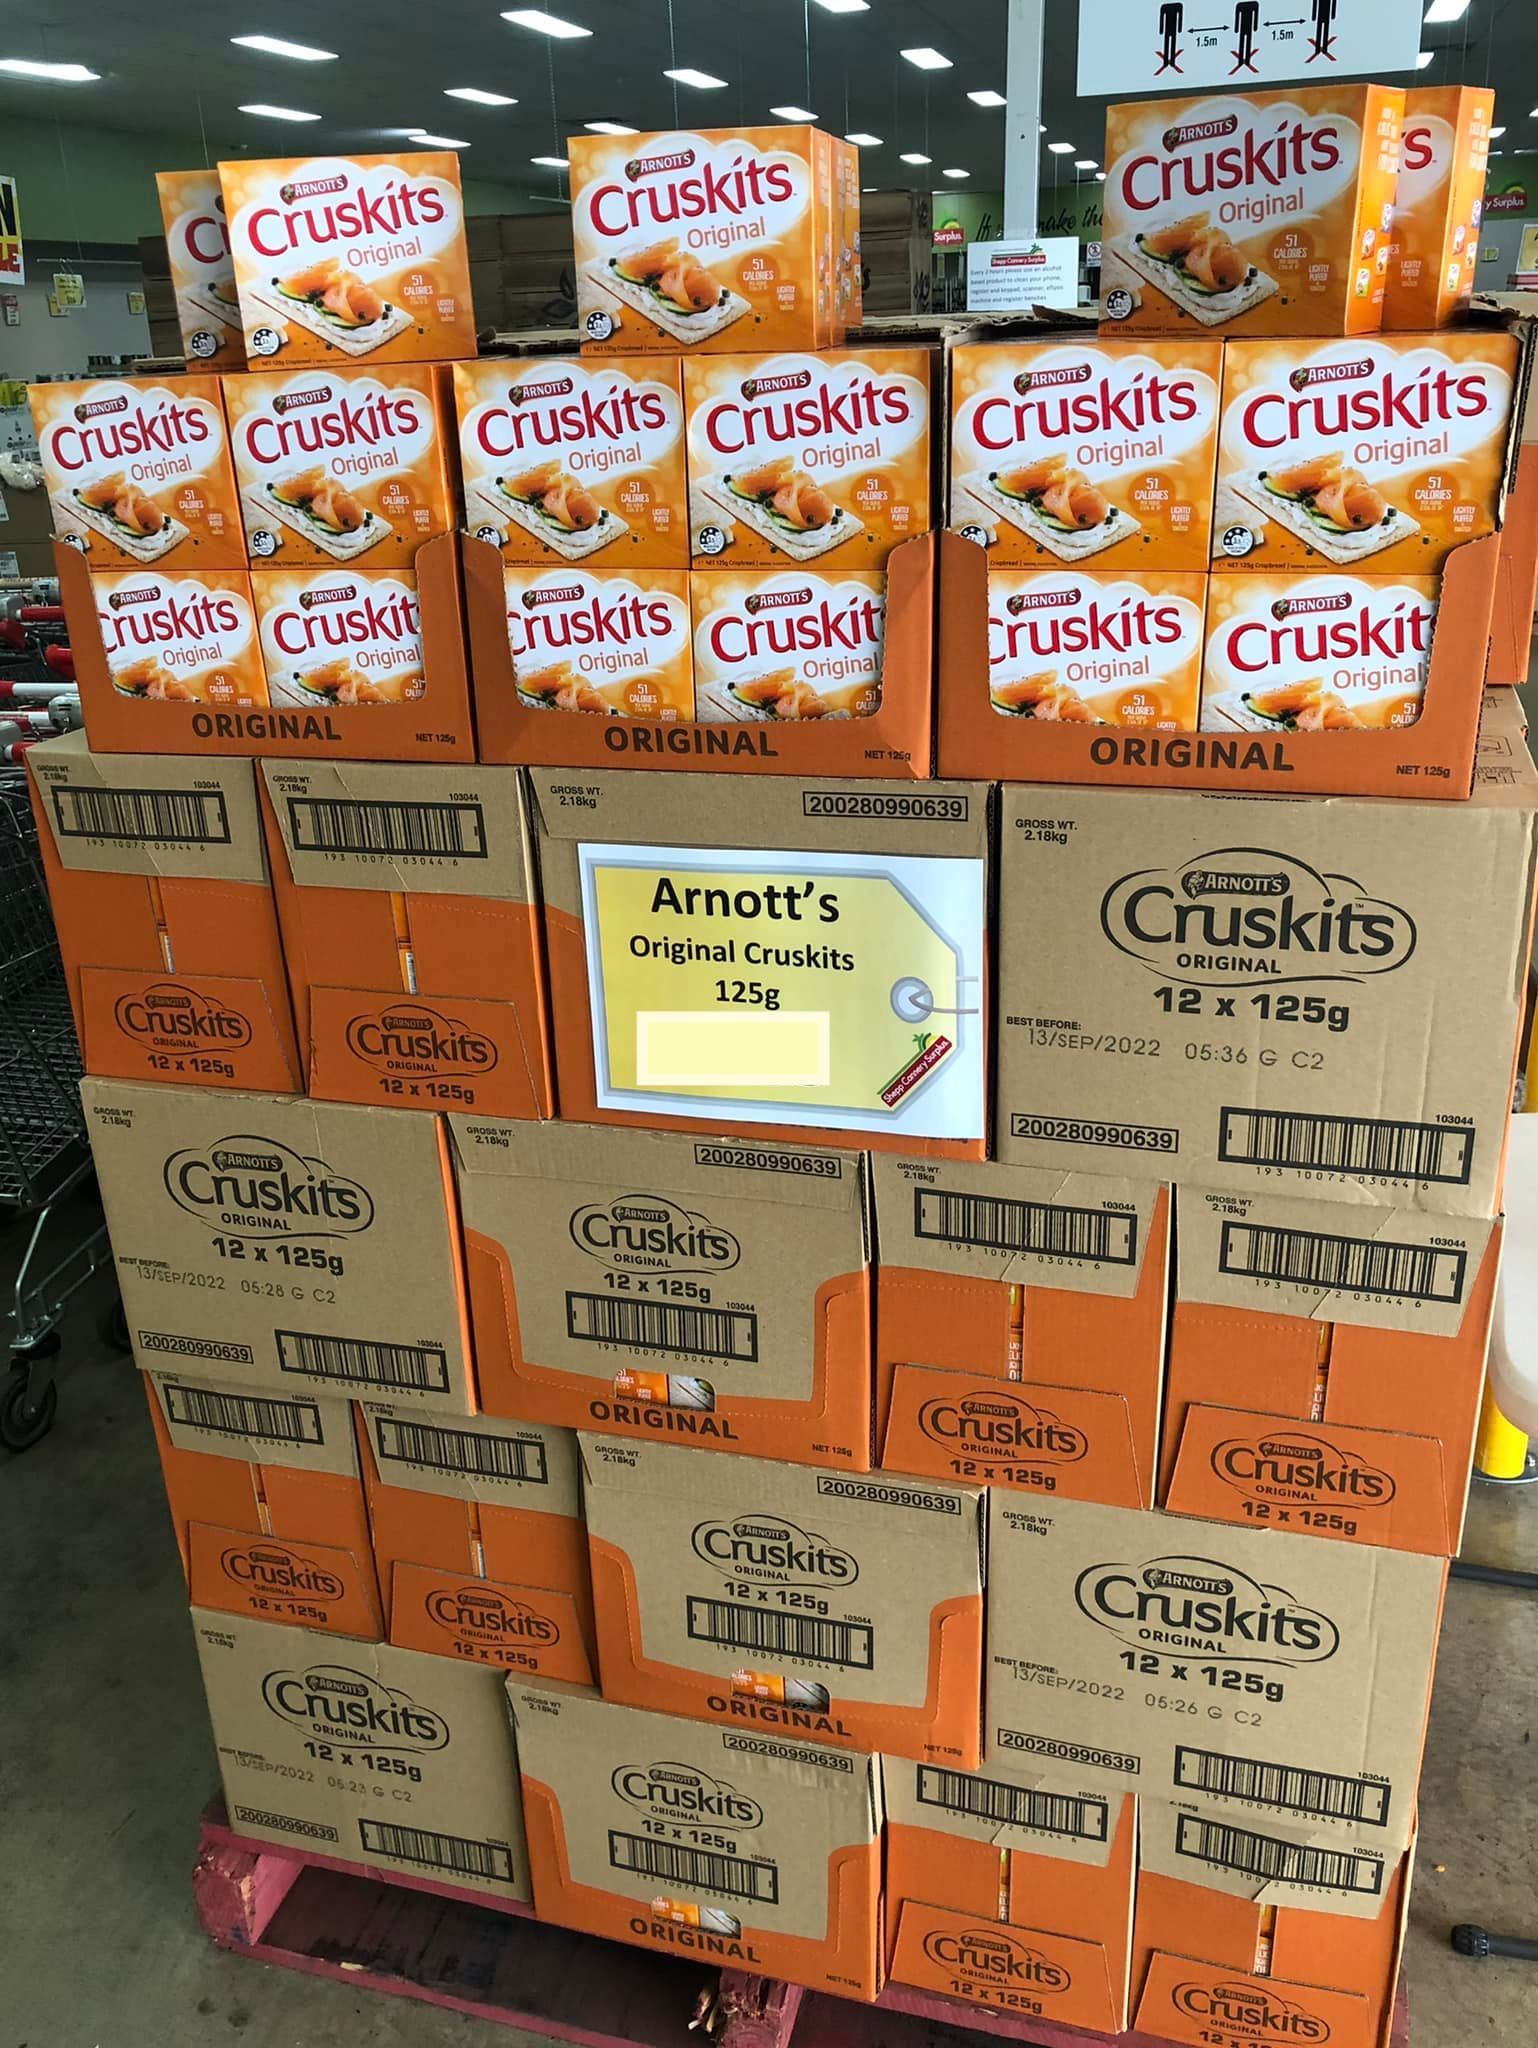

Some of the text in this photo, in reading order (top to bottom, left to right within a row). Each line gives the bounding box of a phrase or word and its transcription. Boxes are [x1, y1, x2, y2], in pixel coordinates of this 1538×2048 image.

[1196, 36, 1218, 47] 1.5m
[1271, 30, 1294, 41] 1.5m
[1178, 116, 1234, 142] ARNOTT'S
[639, 151, 692, 174] ARNOTT'S
[1122, 120, 1339, 211] Cruskits
[294, 176, 345, 197] ARNOTT'S
[590, 156, 793, 236] Cruskits
[248, 181, 445, 257] Cruskits
[1219, 188, 1304, 224] Original
[687, 217, 766, 249] Original
[933, 231, 962, 244] Surplus
[1284, 234, 1298, 247] 51
[347, 237, 422, 268] Original
[1273, 247, 1308, 259] CALORIES
[756, 372, 808, 392] ARNOTT'S
[1030, 367, 1087, 386] ARNOTT'S
[1307, 361, 1369, 382] ARNOTT'S
[522, 379, 570, 397] ARNOTT'S
[477, 385, 666, 457] Cruskits
[706, 377, 910, 453] Cruskits
[972, 372, 1197, 449] Cruskits
[1243, 366, 1488, 449] Cruskits
[51, 401, 209, 470] Cruskits
[246, 392, 419, 463] Cruskits
[331, 447, 399, 475] Original
[569, 442, 642, 471] Original
[802, 437, 881, 468] Original
[1076, 434, 1164, 466] Original
[1354, 432, 1448, 464] Original
[131, 454, 192, 482] Original
[1145, 477, 1159, 489] 51
[1427, 476, 1442, 488] 51
[1134, 489, 1168, 500] CALORIES
[1415, 488, 1452, 500] CALORIES
[759, 590, 809, 606] ARNOTT'S
[1022, 591, 1077, 607] ARNOTT'S
[1289, 595, 1347, 612] ARNOTT'S
[273, 593, 421, 654] Cruskit
[710, 595, 887, 663] Cruskit
[1227, 599, 1436, 672] Cruskit
[162, 641, 223, 667] Original
[355, 645, 421, 669] Original
[578, 648, 649, 674] Original
[803, 654, 879, 679] Original
[1066, 656, 1150, 682] Original
[1332, 662, 1424, 690] Original
[192, 712, 342, 741] ORIGINAL
[604, 726, 779, 757] ORIGINAL
[864, 749, 911, 762] NET 125g
[1090, 737, 1294, 772] ORIGINAL
[1395, 764, 1451, 778] NET 125g
[809, 796, 963, 818] 200280990639
[1015, 819, 1078, 831] GROSS WT.
[1024, 829, 1068, 845] 2.18kg
[1204, 873, 1283, 894] ARNOTT'S
[1123, 885, 1395, 956] Cruskits
[629, 935, 855, 971] Original Cruskits
[1176, 952, 1282, 974] ORIGINAL
[715, 979, 780, 1010] 125g
[1153, 987, 1350, 1031] 12 x 125g
[124, 1002, 244, 1040] Cruskits
[1006, 1016, 1082, 1031] BEST BEFORE:
[356, 1023, 489, 1064] Cruskits
[1027, 1027, 1325, 1070] 13/SEP/2022 05:36 G C2
[883, 1040, 949, 1103] Shepp Cannery Surplus
[1017, 1117, 1174, 1150] 200280990639
[1434, 1113, 1474, 1126] 103044
[700, 1148, 837, 1175] 200280990639
[179, 1160, 360, 1220] Cruskits
[1256, 1166, 1430, 1191] 193 10072 03044 6
[582, 1212, 729, 1260] Cruskits
[211, 1237, 344, 1277] 12 x 125g
[136, 1265, 336, 1304] 13/SEP/2022 05:28 C2
[143, 1334, 249, 1361] 200280990639
[589, 1400, 739, 1440] ORIGINAL
[930, 1405, 1078, 1454] Cruskits
[1224, 1447, 1385, 1498] Cruskits
[823, 1480, 956, 1511] 200280990639
[704, 1527, 849, 1578] Cruskits
[229, 1554, 337, 1596] Cruskits
[1161, 1572, 1228, 1594] ARNOTT'S
[435, 1596, 551, 1640] Cruskits
[1094, 1575, 1322, 1651] Cruskits
[1119, 1651, 1285, 1702] 12 x 125g
[276, 1679, 438, 1741] Cruskits
[1011, 1666, 1263, 1728] 13/SEP/2022 05:26 G C2
[707, 1695, 852, 1737] ORIGINAL
[1002, 1732, 1136, 1772] 200280990639
[622, 1772, 754, 1823] Cruskits
[240, 1807, 336, 1840] 200280990639
[629, 1918, 762, 1963] ORIGINAL
[935, 1934, 1062, 1987] Cruskits
[1183, 1987, 1320, 2038] Cruskits
